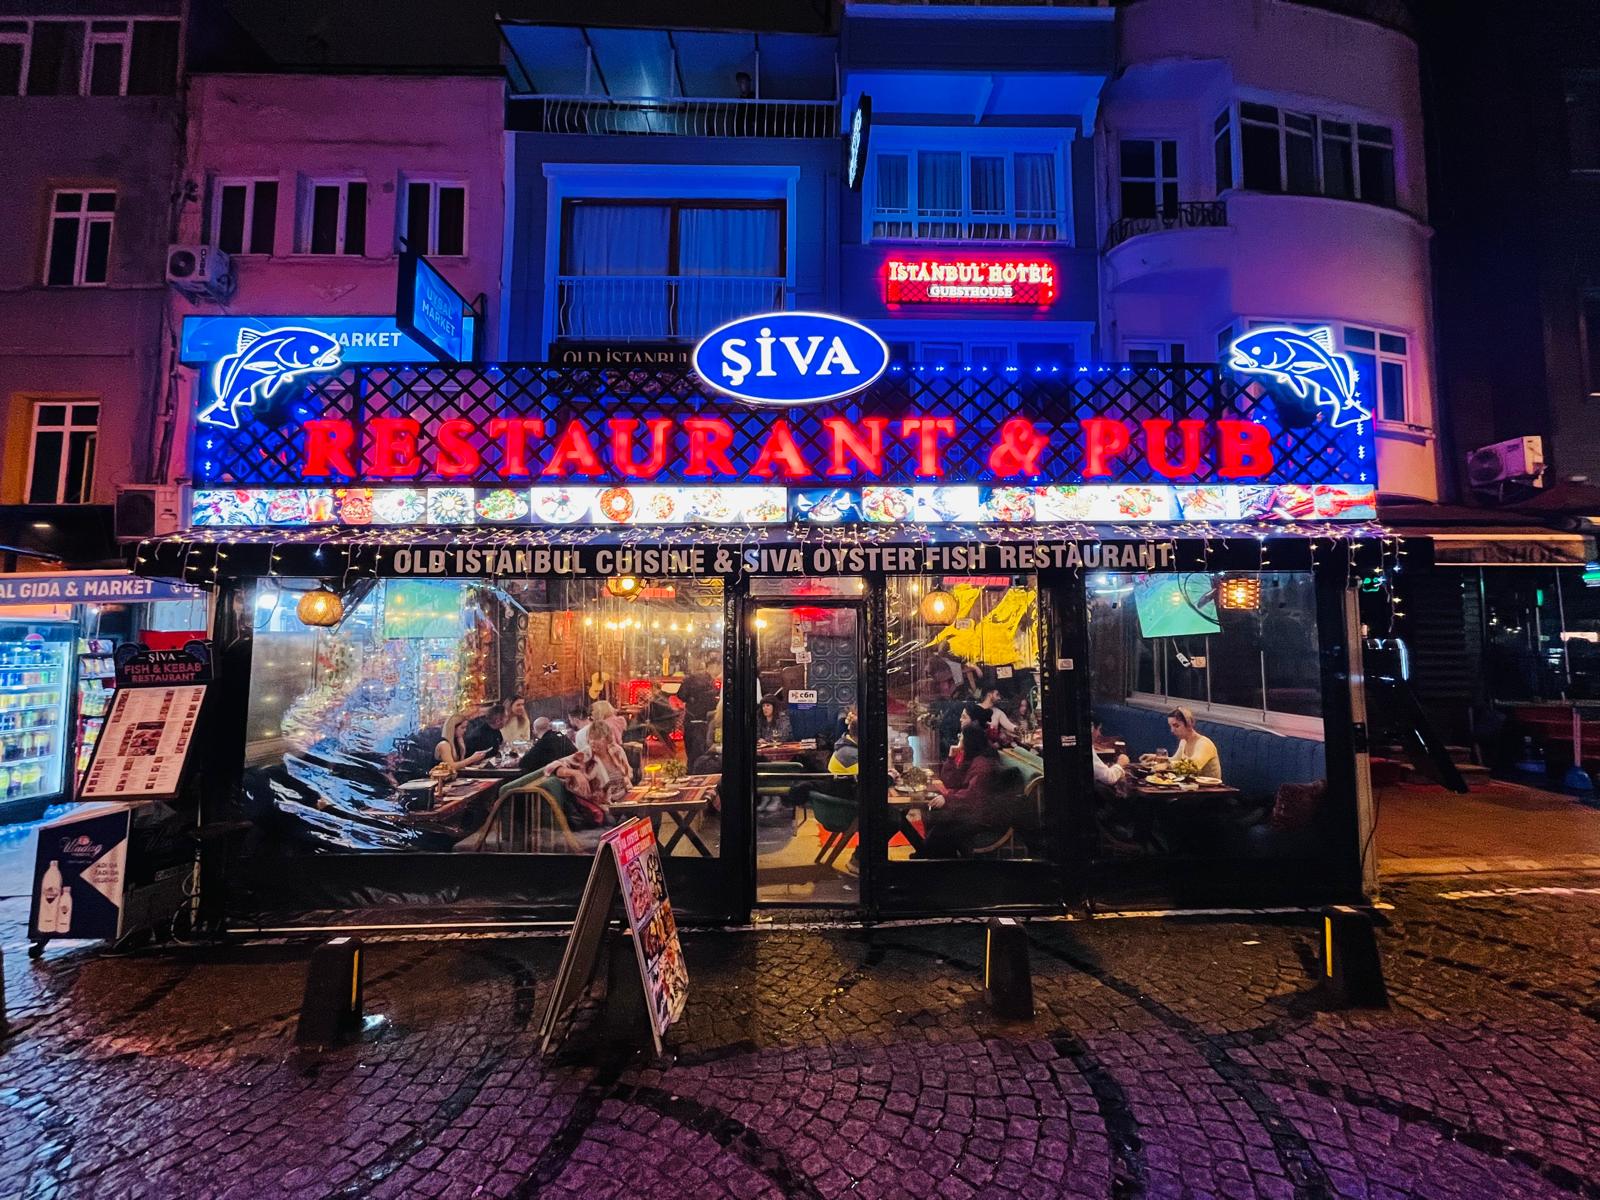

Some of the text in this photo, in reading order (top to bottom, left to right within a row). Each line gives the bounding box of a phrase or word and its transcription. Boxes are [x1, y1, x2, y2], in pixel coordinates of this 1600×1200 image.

[988, 263, 1052, 284] HOTEL
[929, 285, 1014, 298] GUESTHOUSE
[421, 300, 456, 337] MARKET
[721, 327, 861, 387] ŞİVA
[303, 417, 1276, 479] RESTAURANT & PUB
[393, 543, 1173, 575] OLD ISTANBUL CUISINE & SIVA OYSTER FISH RESTAURANT
[20, 582, 61, 599] GIDA
[65, 581, 79, 597] &
[84, 579, 154, 597] MARKET
[124, 661, 202, 675] FISH & KEBAB
[131, 672, 196, 683] RESTAURANT
